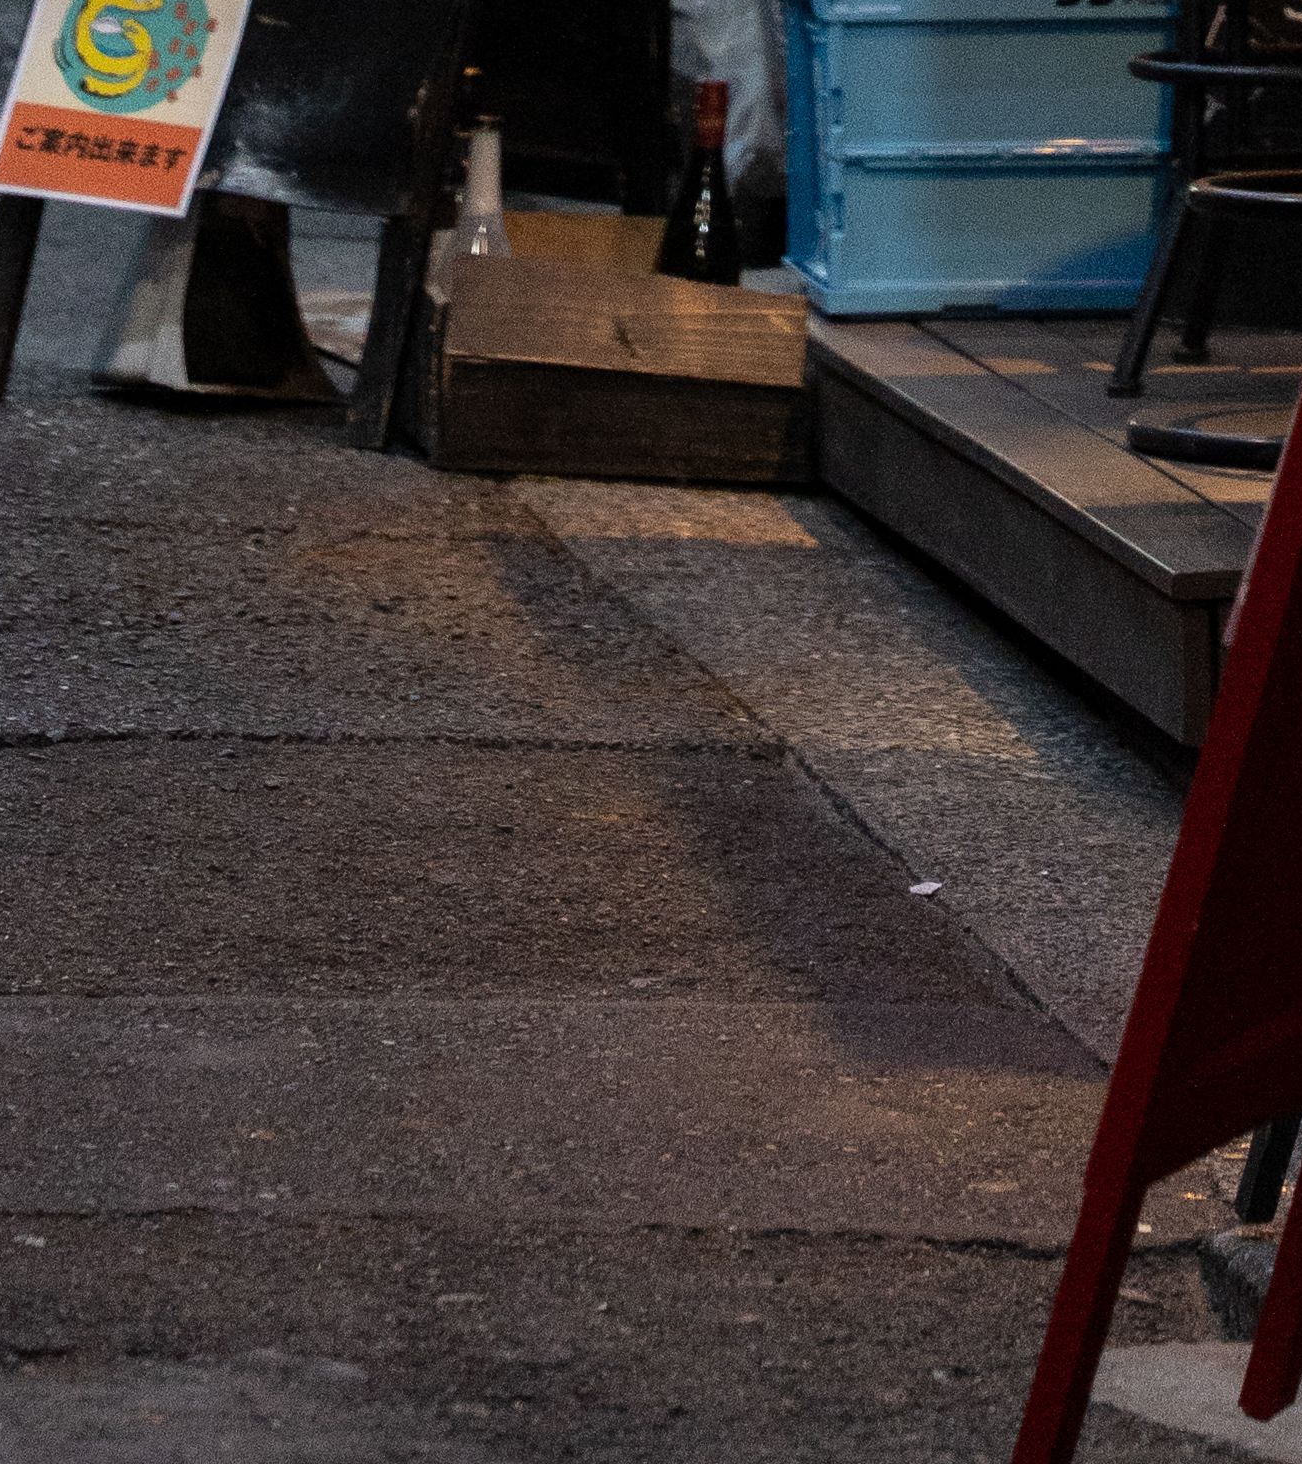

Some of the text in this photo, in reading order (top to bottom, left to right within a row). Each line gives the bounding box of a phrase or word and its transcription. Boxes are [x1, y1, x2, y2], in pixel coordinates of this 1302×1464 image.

[14, 126, 188, 171] ご案内出来ます
